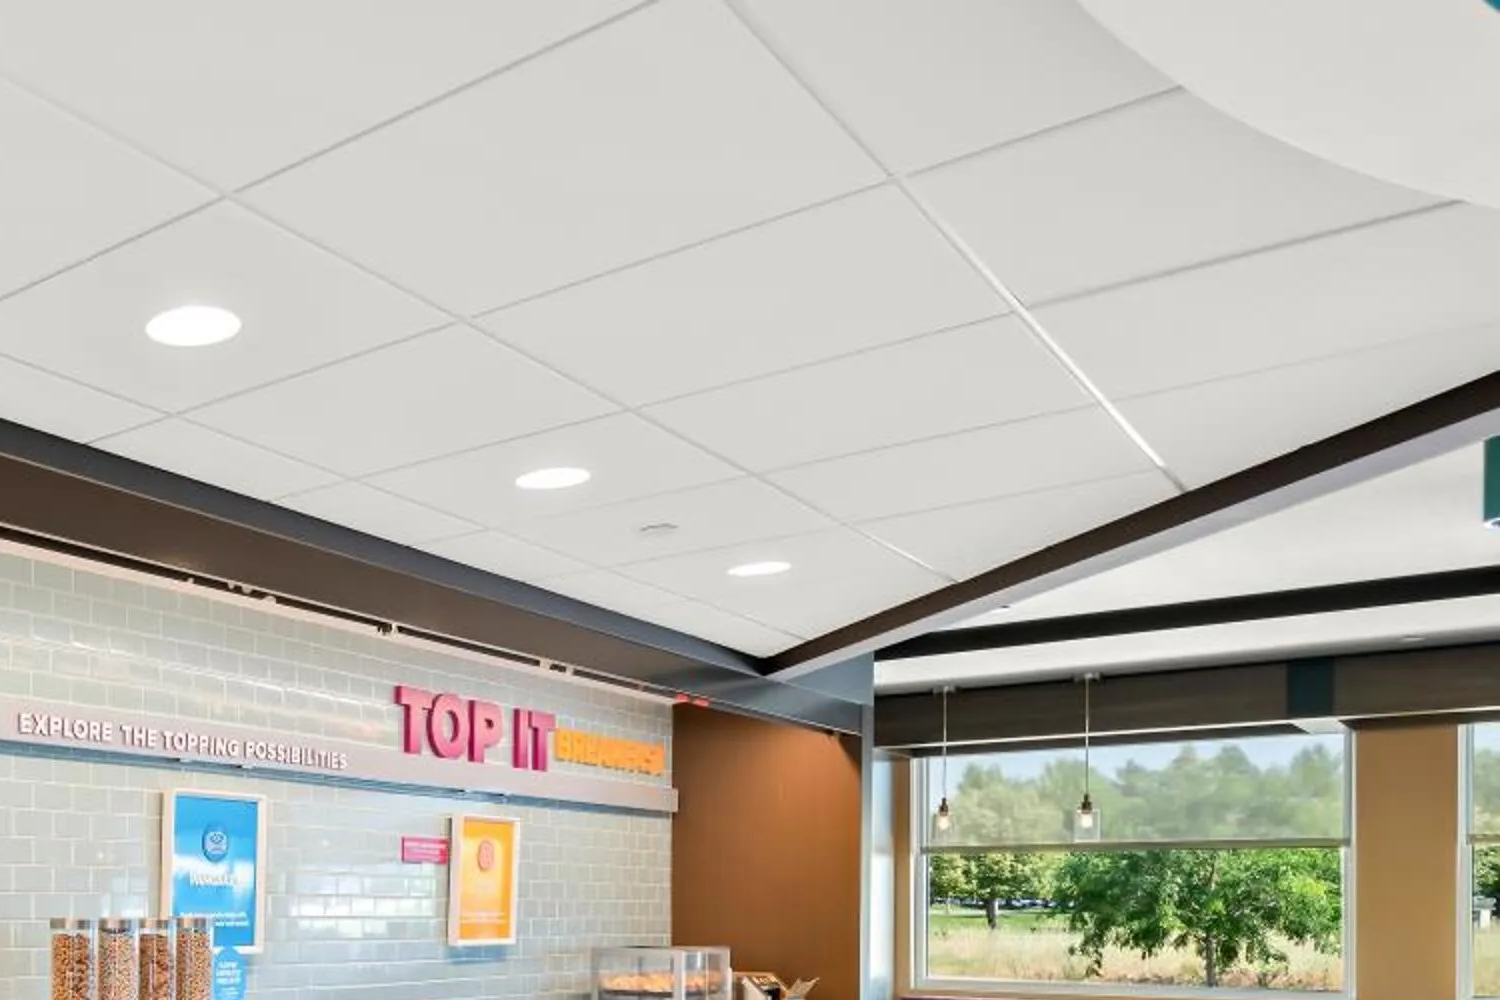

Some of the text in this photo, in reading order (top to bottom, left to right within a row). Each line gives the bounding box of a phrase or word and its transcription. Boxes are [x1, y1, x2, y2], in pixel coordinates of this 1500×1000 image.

[18, 712, 349, 770] EXPLORE THE TOPPING POSSIBILITIES
[393, 685, 556, 772] TOP IT
